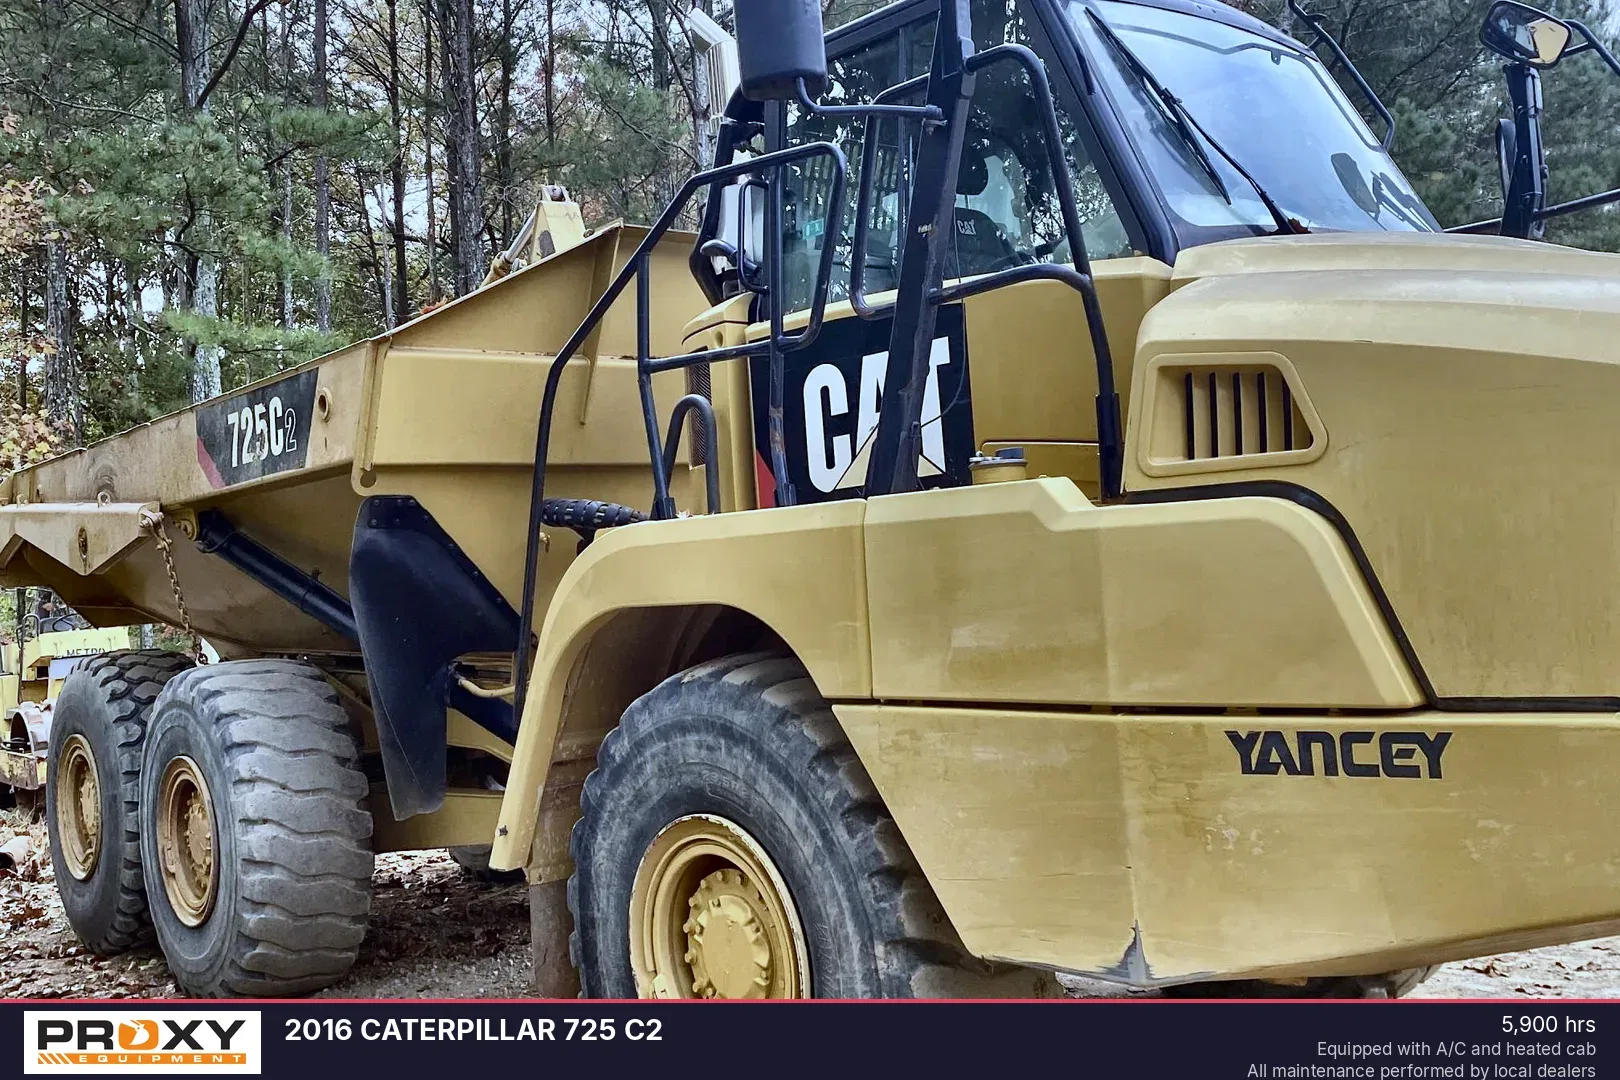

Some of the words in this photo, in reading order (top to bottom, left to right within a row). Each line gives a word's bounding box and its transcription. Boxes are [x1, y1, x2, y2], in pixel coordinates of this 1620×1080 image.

[957, 219, 977, 235] CAT
[803, 336, 951, 493] CAT
[1224, 730, 1454, 780] YANCEY
